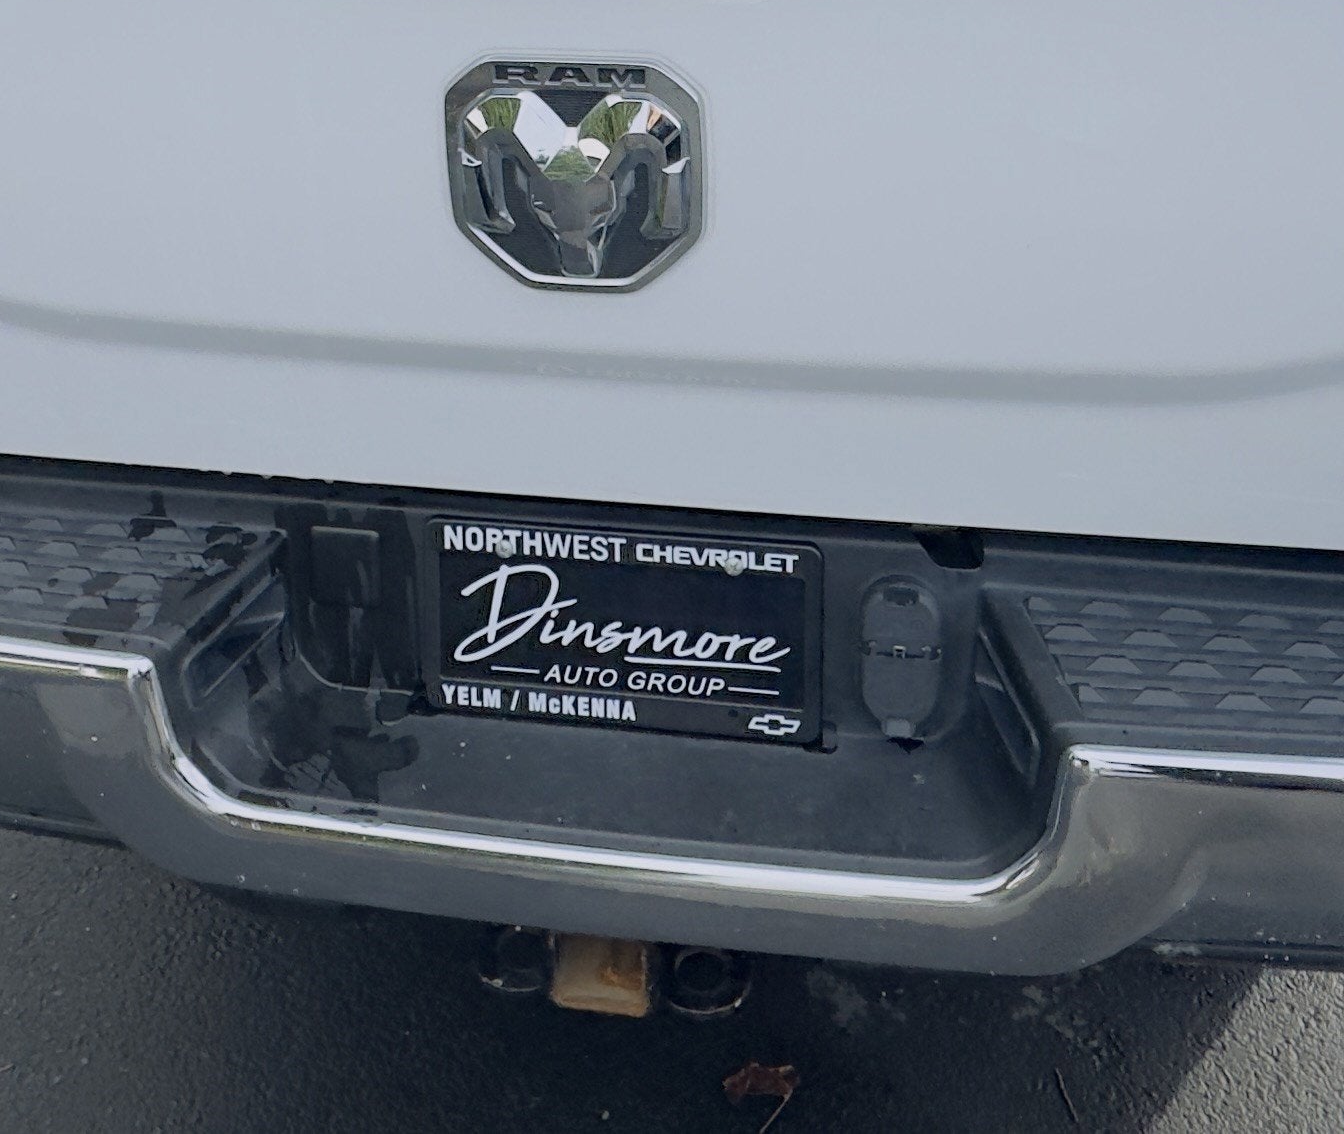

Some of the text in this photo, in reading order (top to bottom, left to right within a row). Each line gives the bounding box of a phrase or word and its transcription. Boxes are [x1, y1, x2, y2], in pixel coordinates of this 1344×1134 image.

[492, 65, 647, 89] RAM
[443, 524, 800, 574] NORTHWEST CHEVROLET
[454, 563, 791, 663] Dinsmore
[544, 664, 728, 697] AUTO GROUP
[441, 683, 637, 723] YELM / McKENNA
